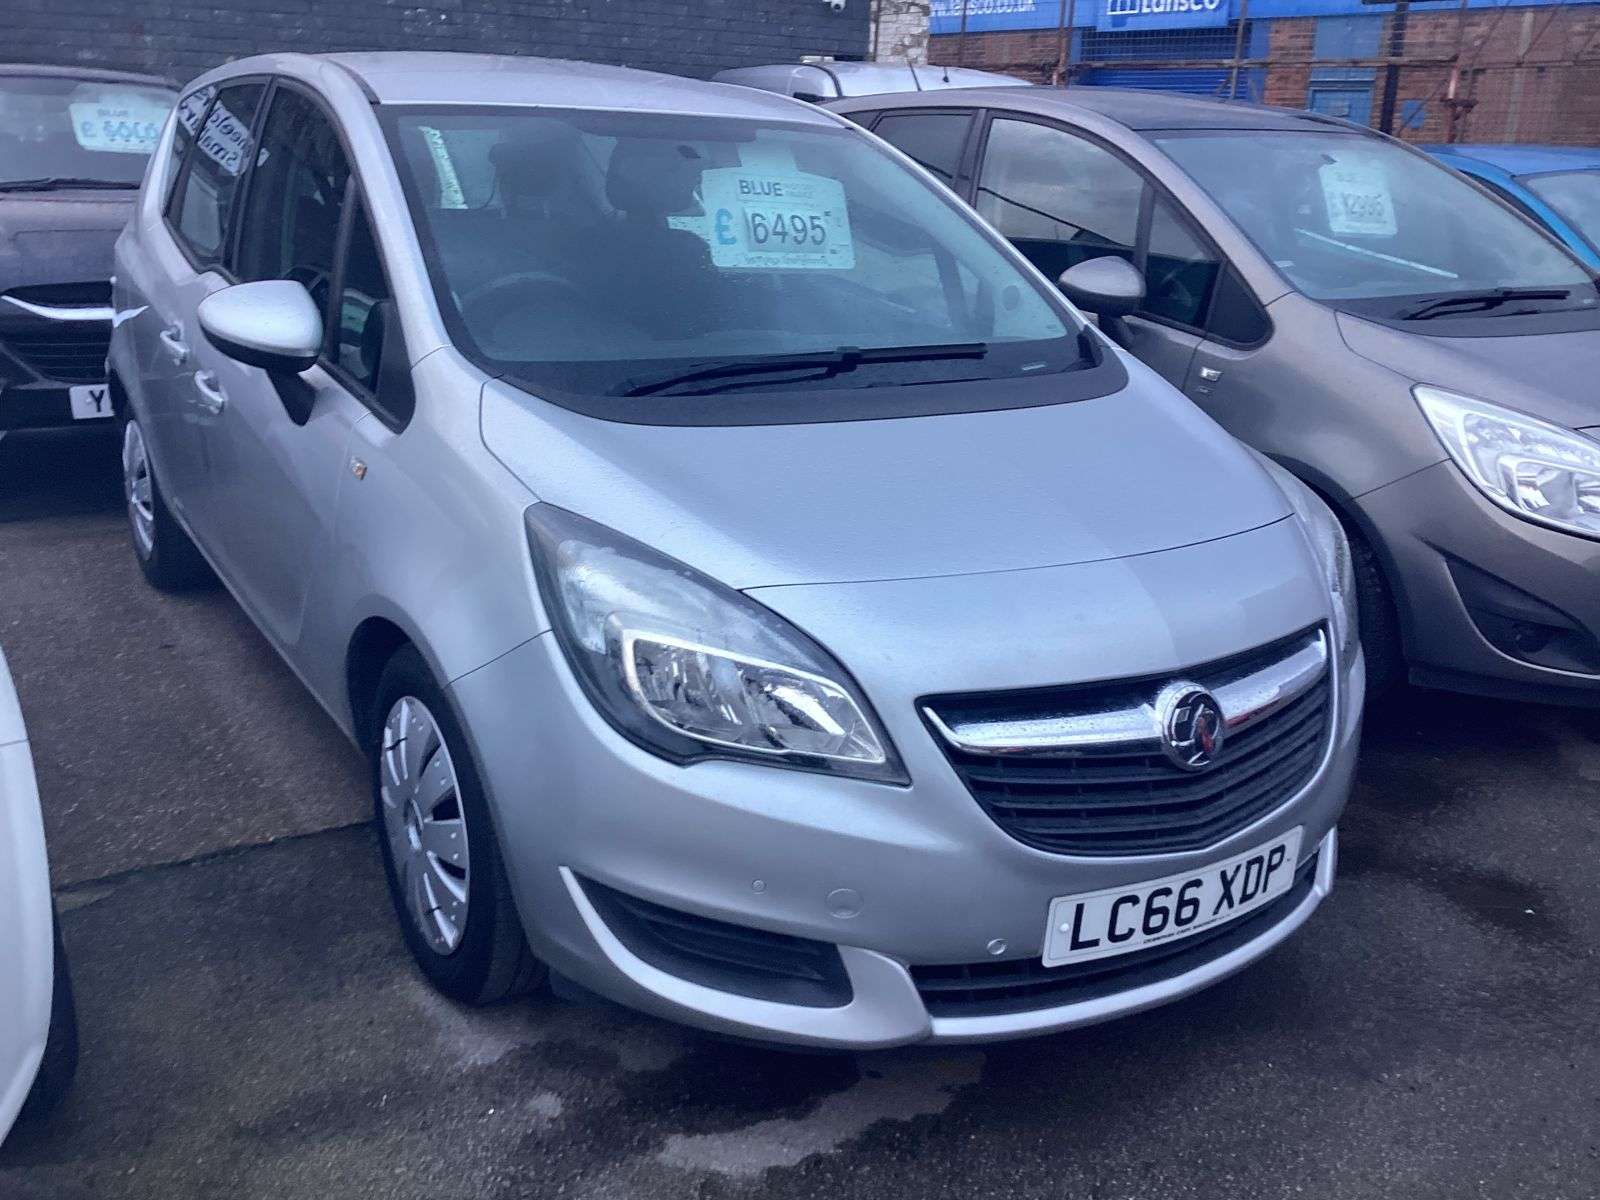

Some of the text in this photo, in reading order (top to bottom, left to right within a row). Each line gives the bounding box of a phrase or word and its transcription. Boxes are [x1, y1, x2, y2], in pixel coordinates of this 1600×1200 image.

[738, 179, 785, 197] BLUE
[715, 208, 826, 246] £ 6495
[1069, 879, 1204, 951] LC66
[1212, 844, 1287, 916] XDP
